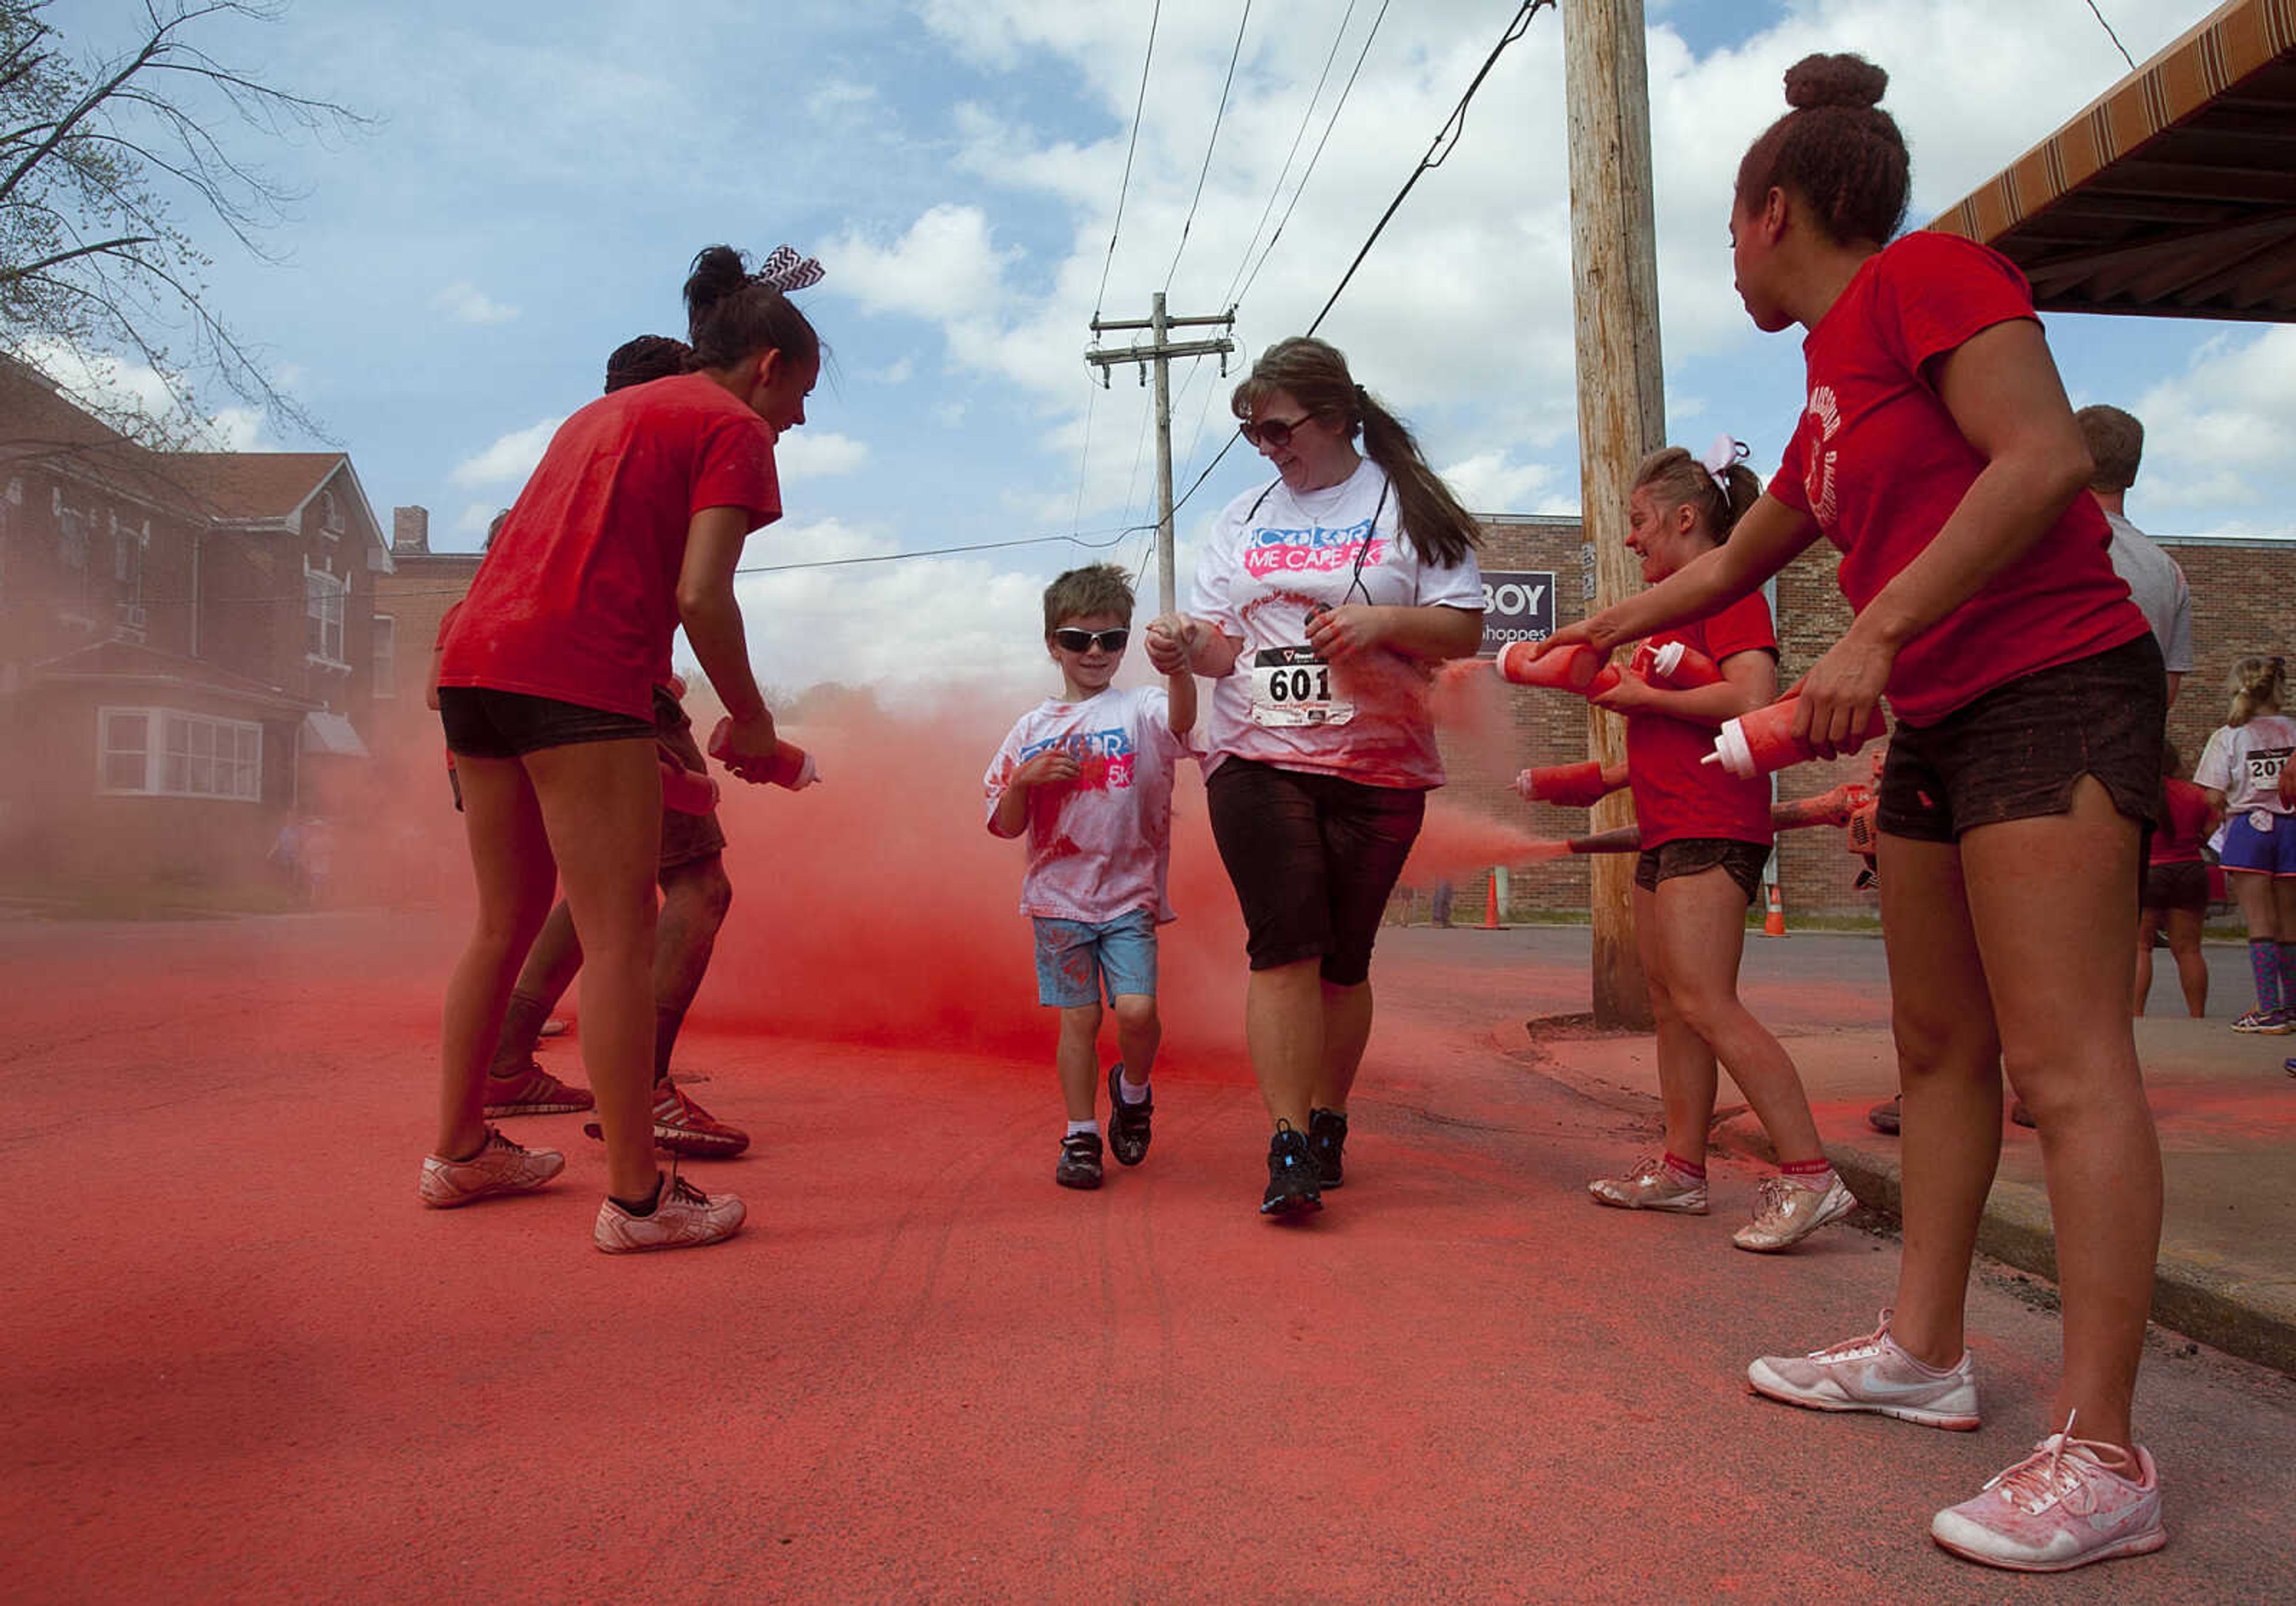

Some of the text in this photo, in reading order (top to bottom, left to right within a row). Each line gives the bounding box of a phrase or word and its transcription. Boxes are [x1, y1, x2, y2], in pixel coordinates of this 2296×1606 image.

[1249, 549, 1281, 568] ME
[1286, 548, 1344, 569] CAPE
[1270, 668, 1332, 702] 601
